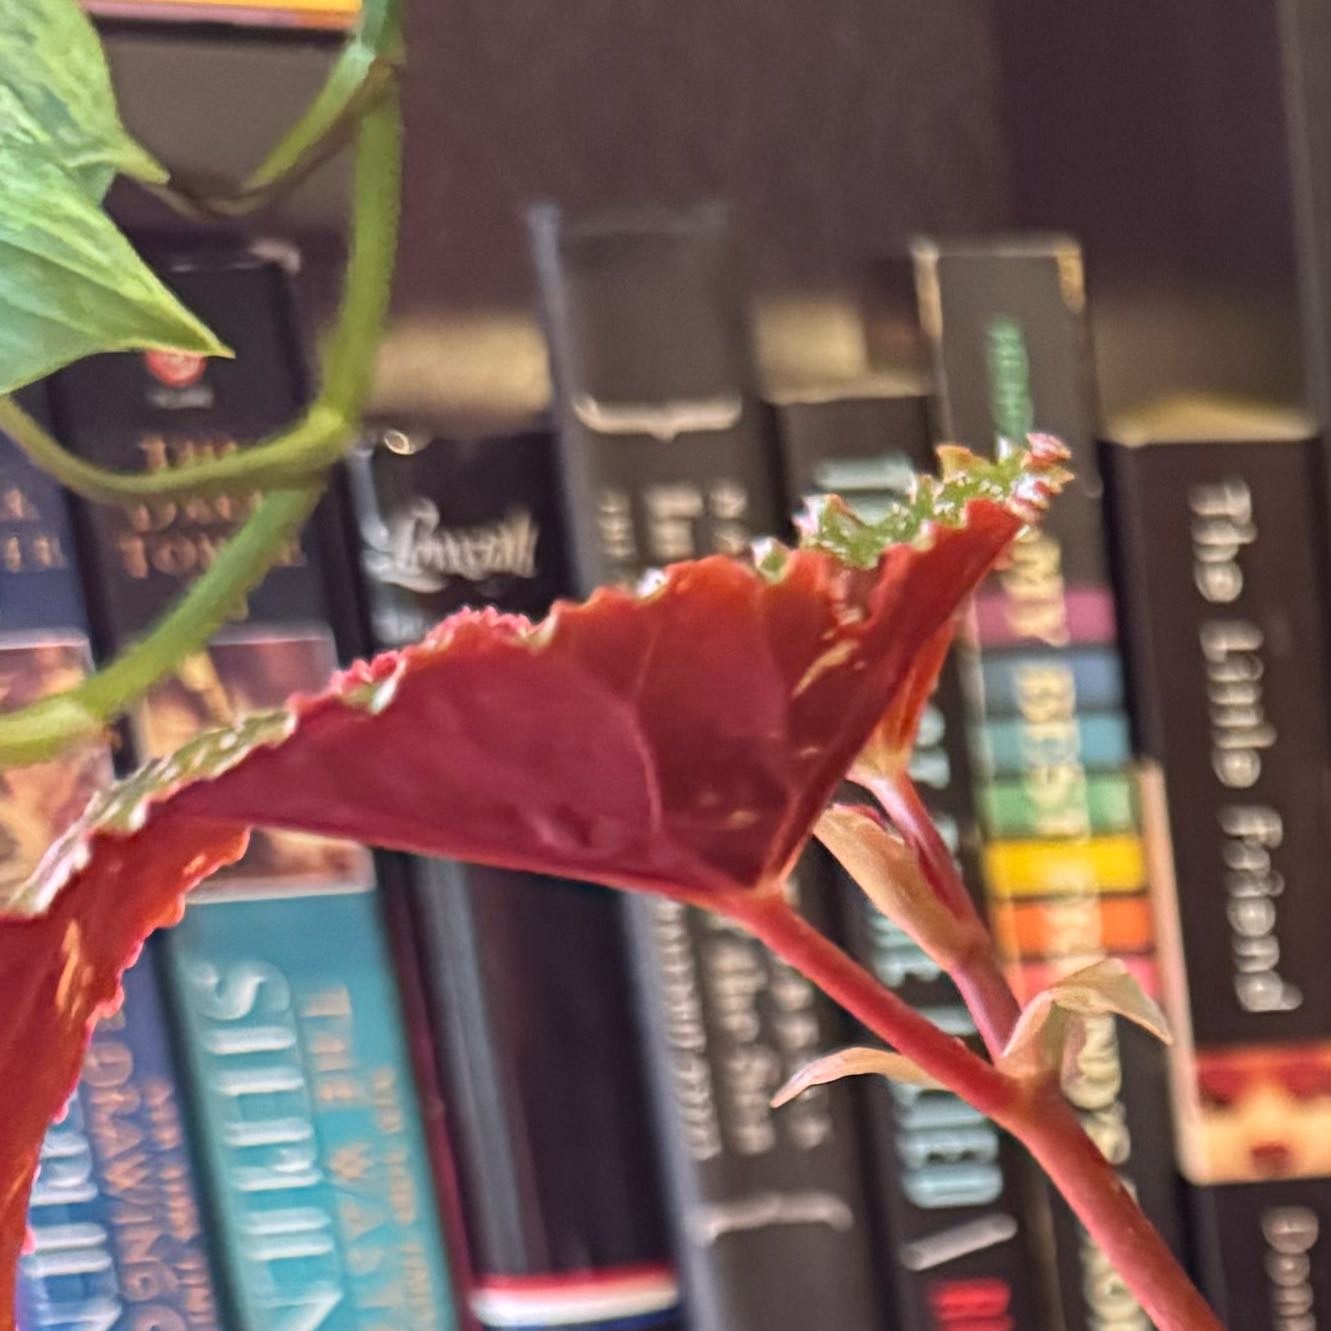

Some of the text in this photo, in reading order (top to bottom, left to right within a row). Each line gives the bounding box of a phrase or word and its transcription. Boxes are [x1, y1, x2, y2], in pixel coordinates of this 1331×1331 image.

[1014, 660, 1091, 842] BEST
[1189, 477, 1304, 1013] The Little Friend
[79, 1040, 178, 1303] DRAWING
